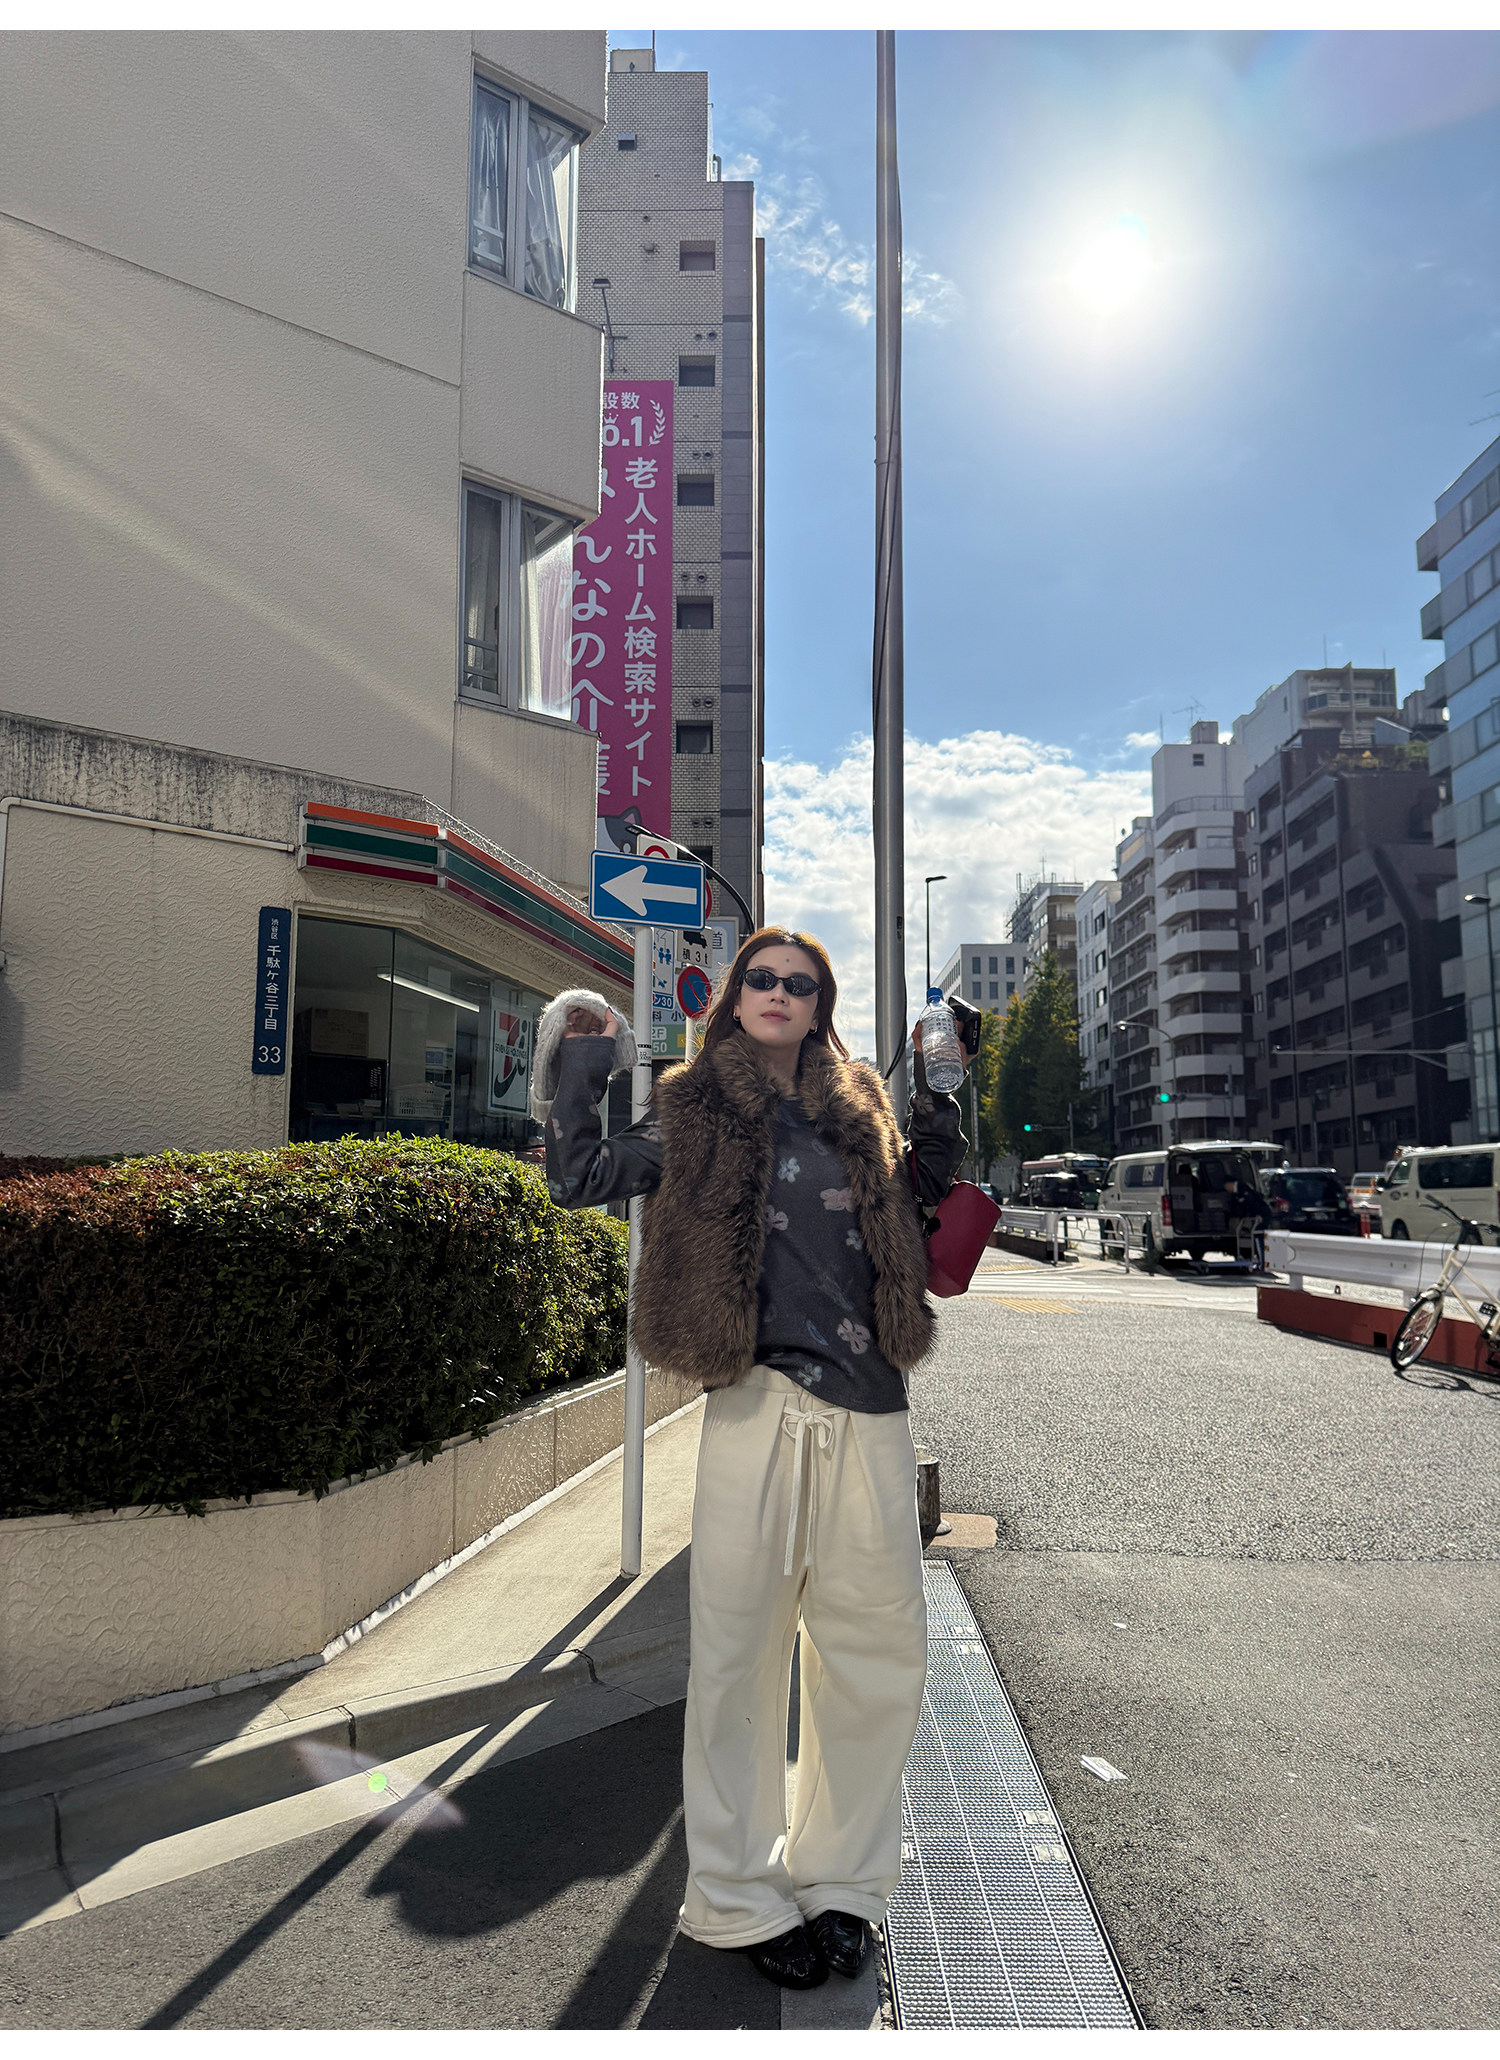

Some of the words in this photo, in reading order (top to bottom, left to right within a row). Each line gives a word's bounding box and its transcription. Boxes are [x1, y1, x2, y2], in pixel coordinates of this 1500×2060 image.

[624, 457, 658, 797] 老人ホーム検索サイト
[258, 1045, 281, 1064] 33
